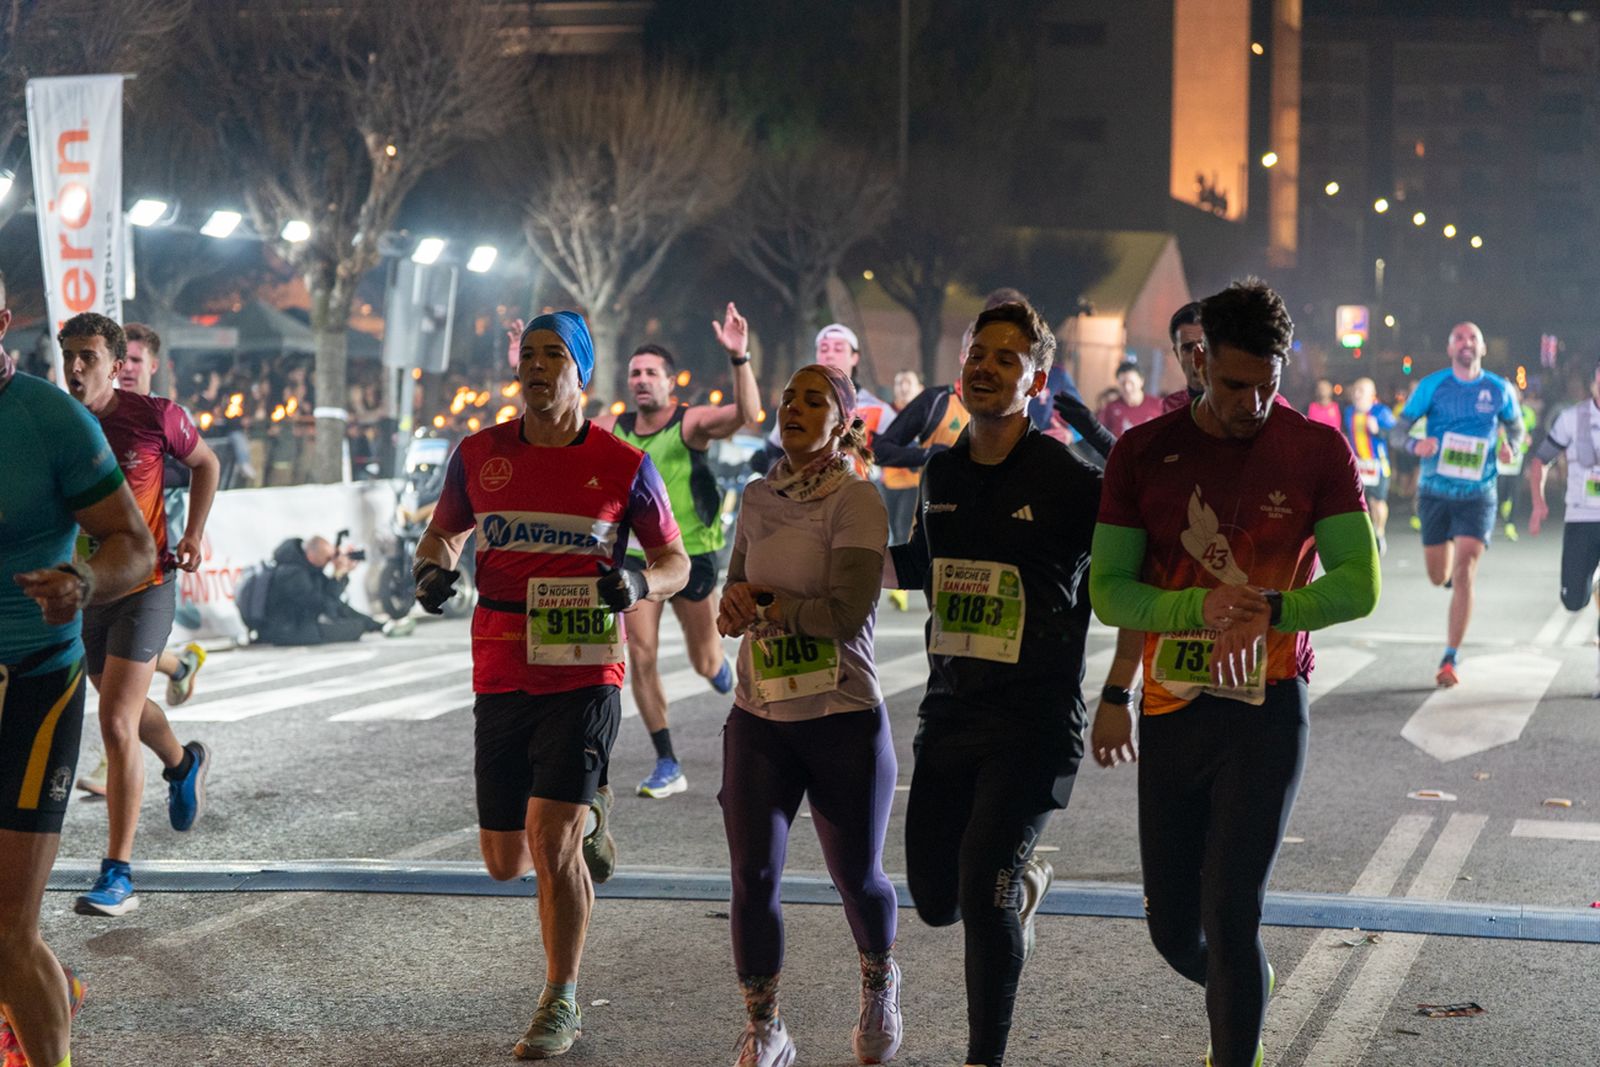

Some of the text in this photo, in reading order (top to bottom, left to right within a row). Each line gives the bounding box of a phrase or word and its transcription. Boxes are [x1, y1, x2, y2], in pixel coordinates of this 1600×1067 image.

[47, 128, 97, 330] erón
[514, 523, 598, 547] Avanza
[1202, 542, 1229, 570] 43
[180, 557, 243, 607] ANTÓ
[943, 580, 960, 592] SAN
[954, 568, 979, 581] NOCHE
[980, 571, 991, 582] DE
[538, 598, 557, 608] SAN
[549, 587, 577, 597] NOCHE
[579, 587, 590, 596] DE
[547, 609, 605, 635] 9158
[947, 593, 1004, 626] 8183
[1174, 641, 1214, 672] 73
